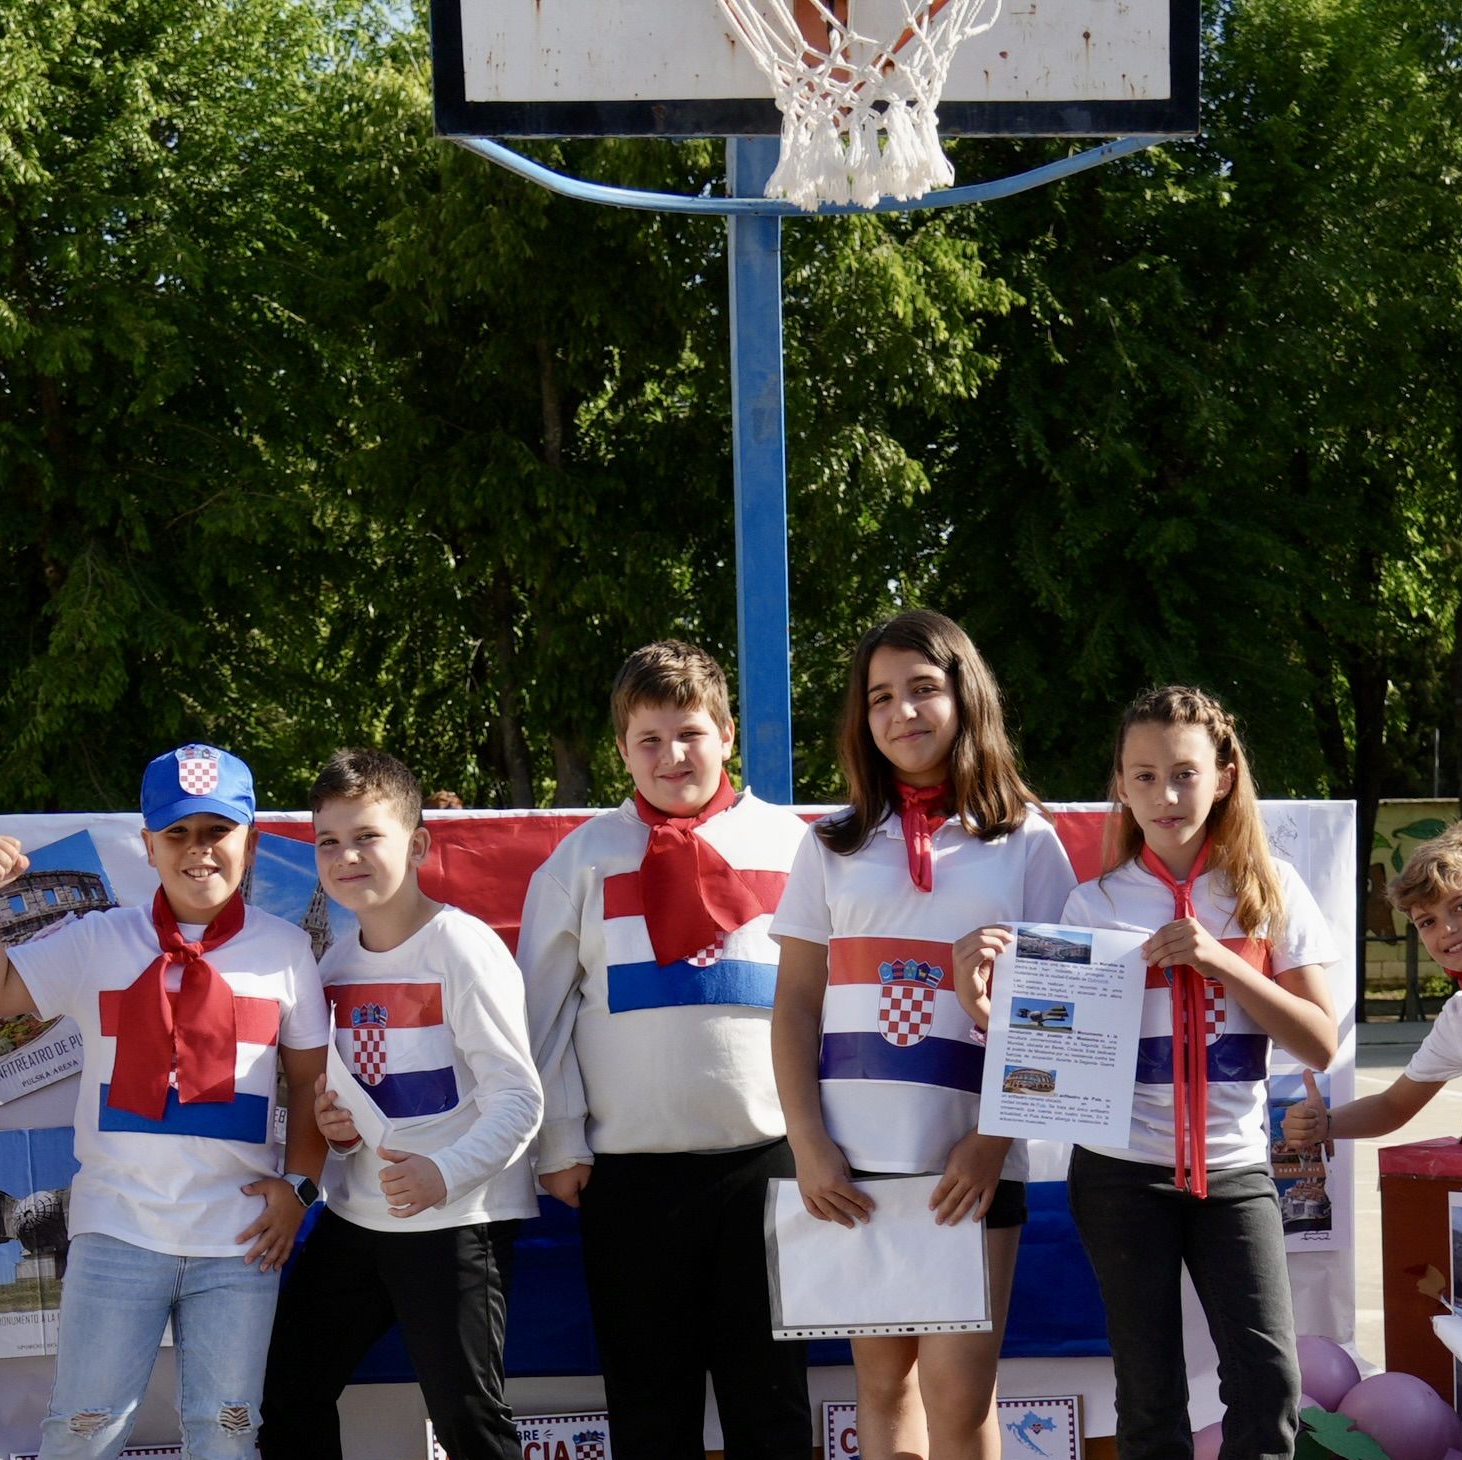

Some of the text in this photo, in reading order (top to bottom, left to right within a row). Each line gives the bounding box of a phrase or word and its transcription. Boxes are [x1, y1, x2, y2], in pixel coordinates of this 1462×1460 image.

[54, 1040, 69, 1056] DE
[68, 1032, 83, 1049] PU
[22, 1072, 50, 1088] PULSKA
